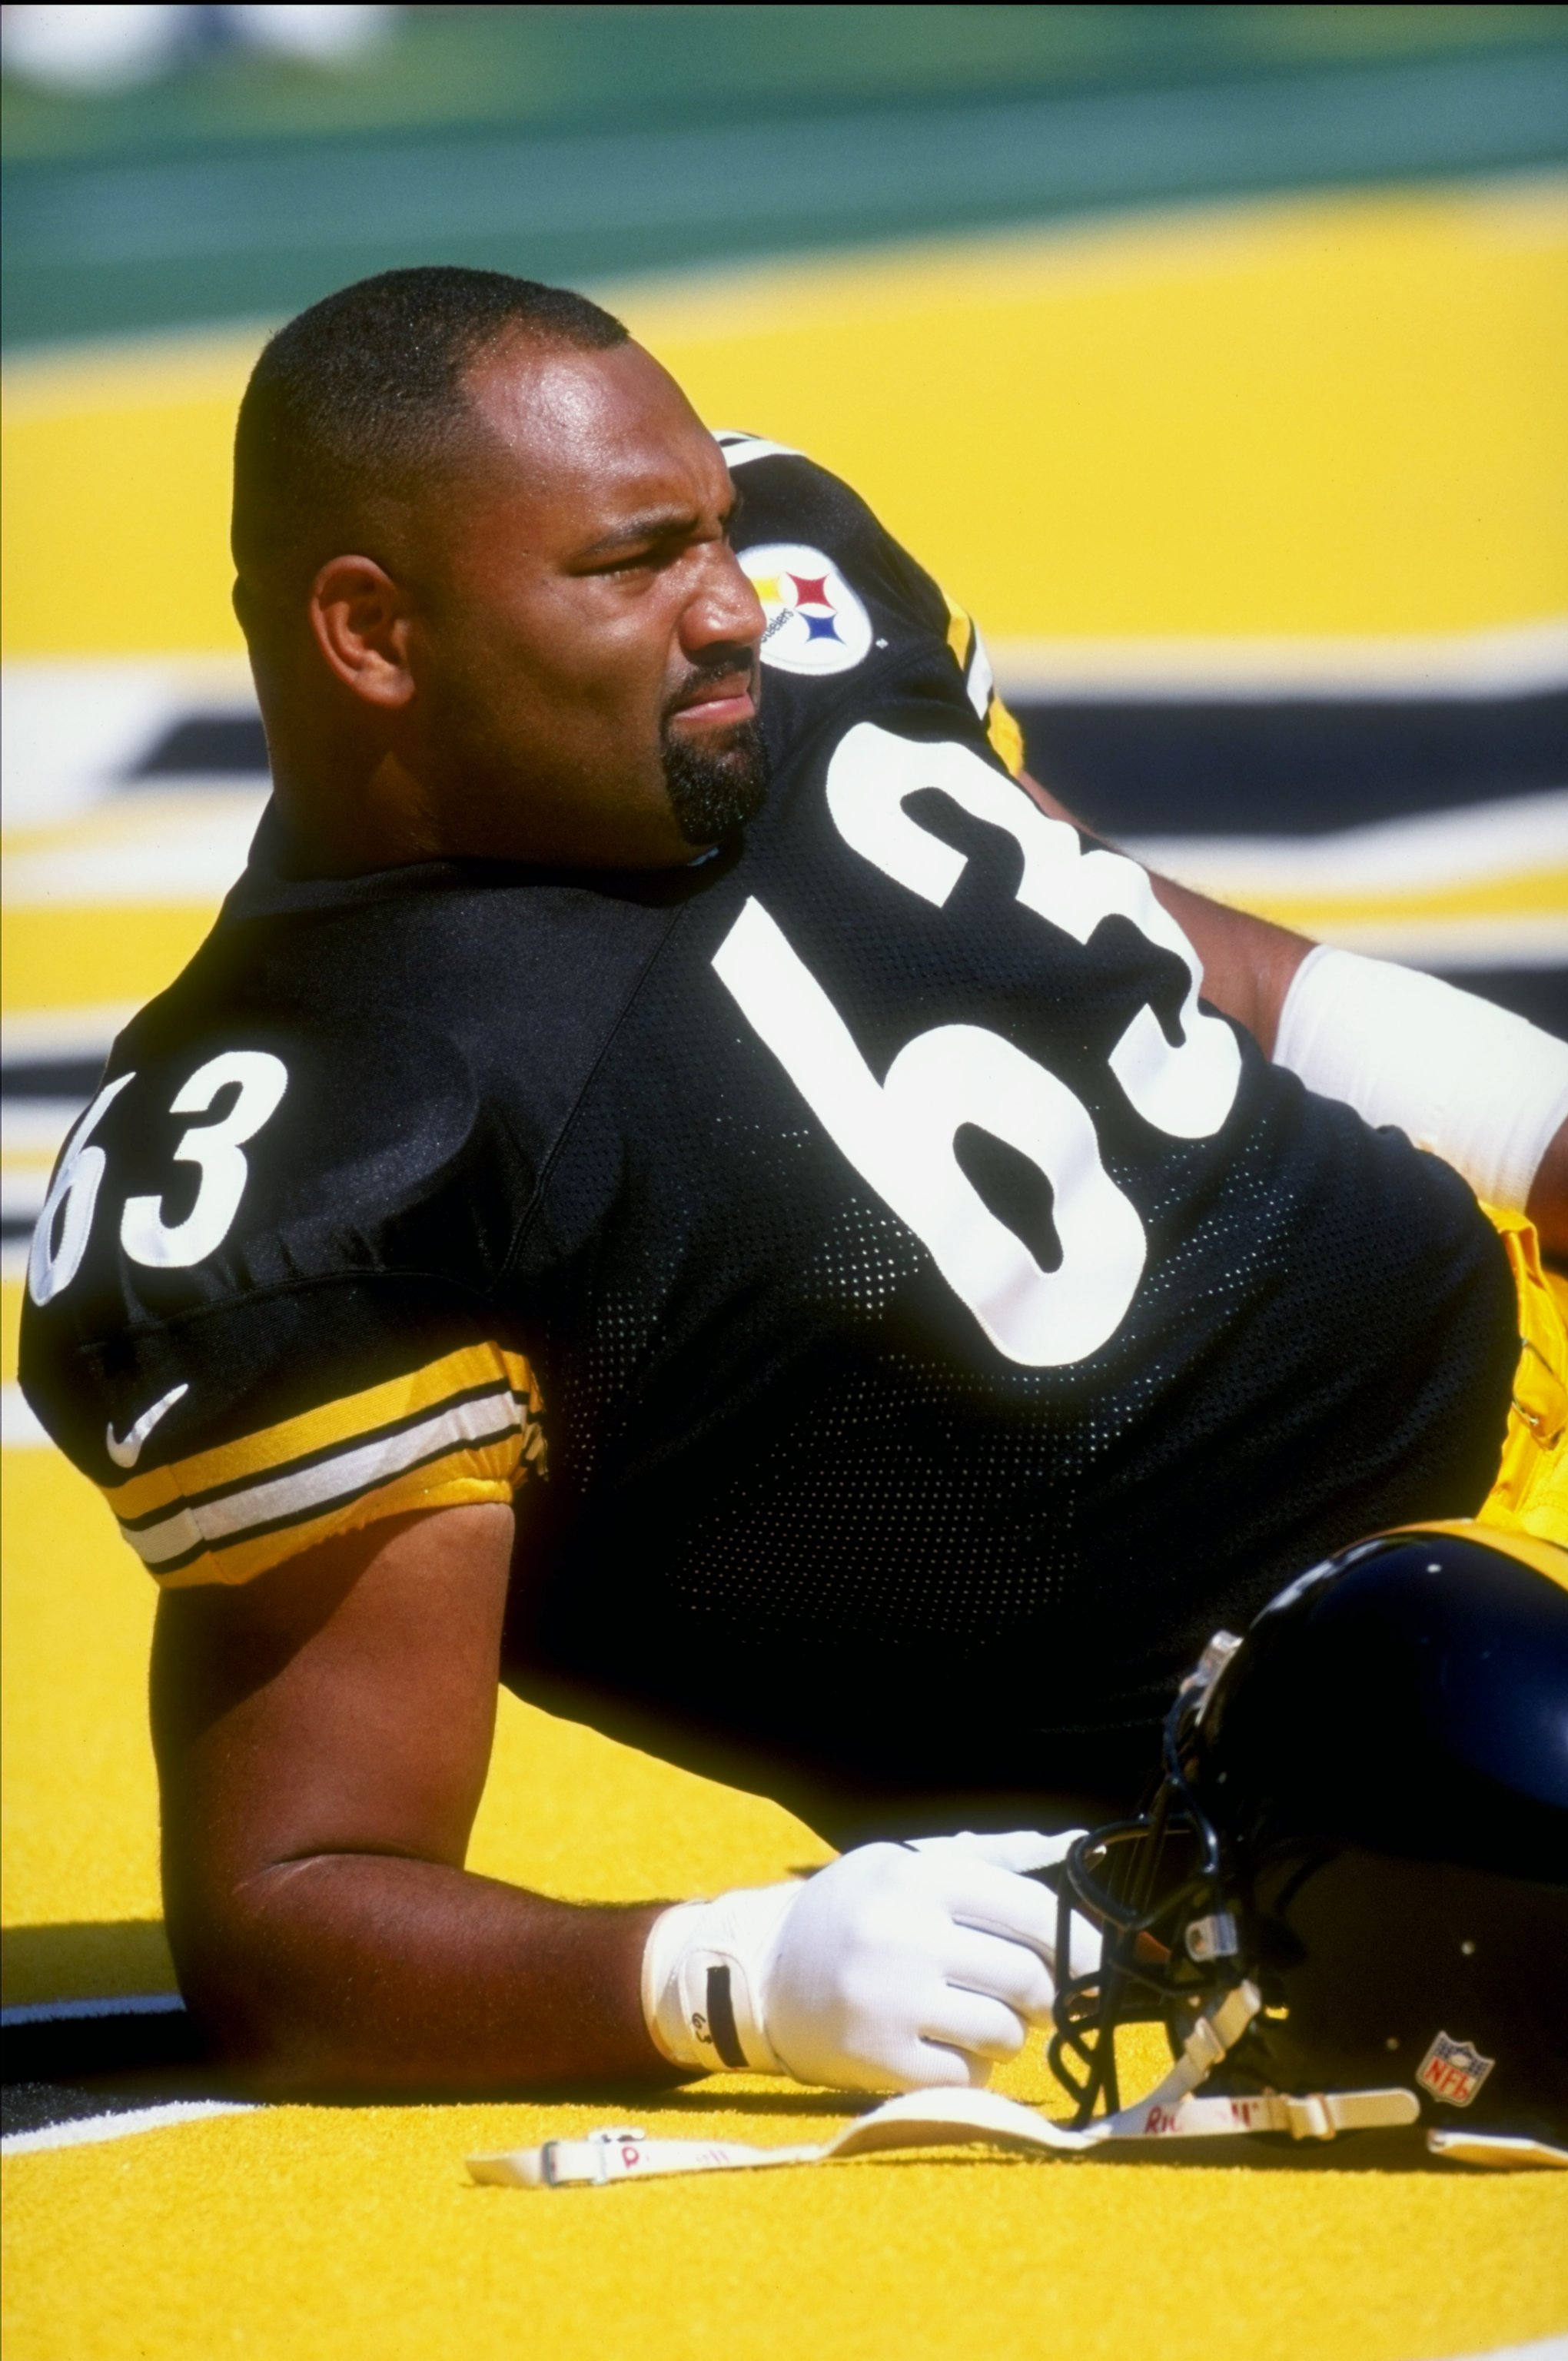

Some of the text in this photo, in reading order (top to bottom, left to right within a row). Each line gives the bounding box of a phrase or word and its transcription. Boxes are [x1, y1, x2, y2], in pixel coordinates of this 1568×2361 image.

[711, 721, 1243, 1367] 63
[28, 1051, 288, 1307] 63
[1423, 2055, 1470, 2102] NFL
